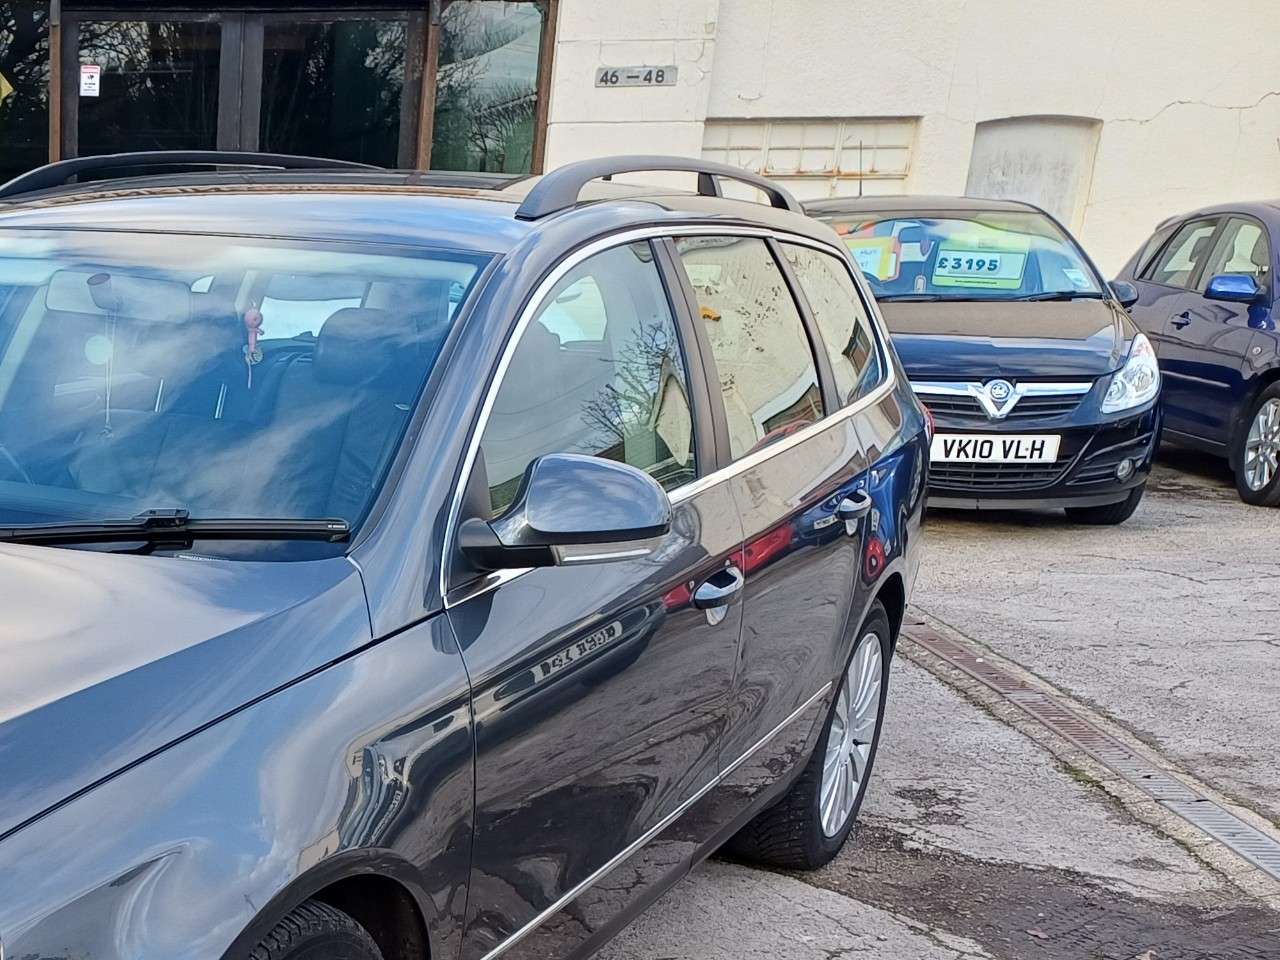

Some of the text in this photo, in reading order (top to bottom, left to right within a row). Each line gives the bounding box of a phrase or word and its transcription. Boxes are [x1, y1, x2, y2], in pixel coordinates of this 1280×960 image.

[599, 69, 619, 85] 46
[643, 69, 665, 84] 48
[937, 257, 999, 272] £3195
[943, 438, 1046, 460] VK10 VLH
